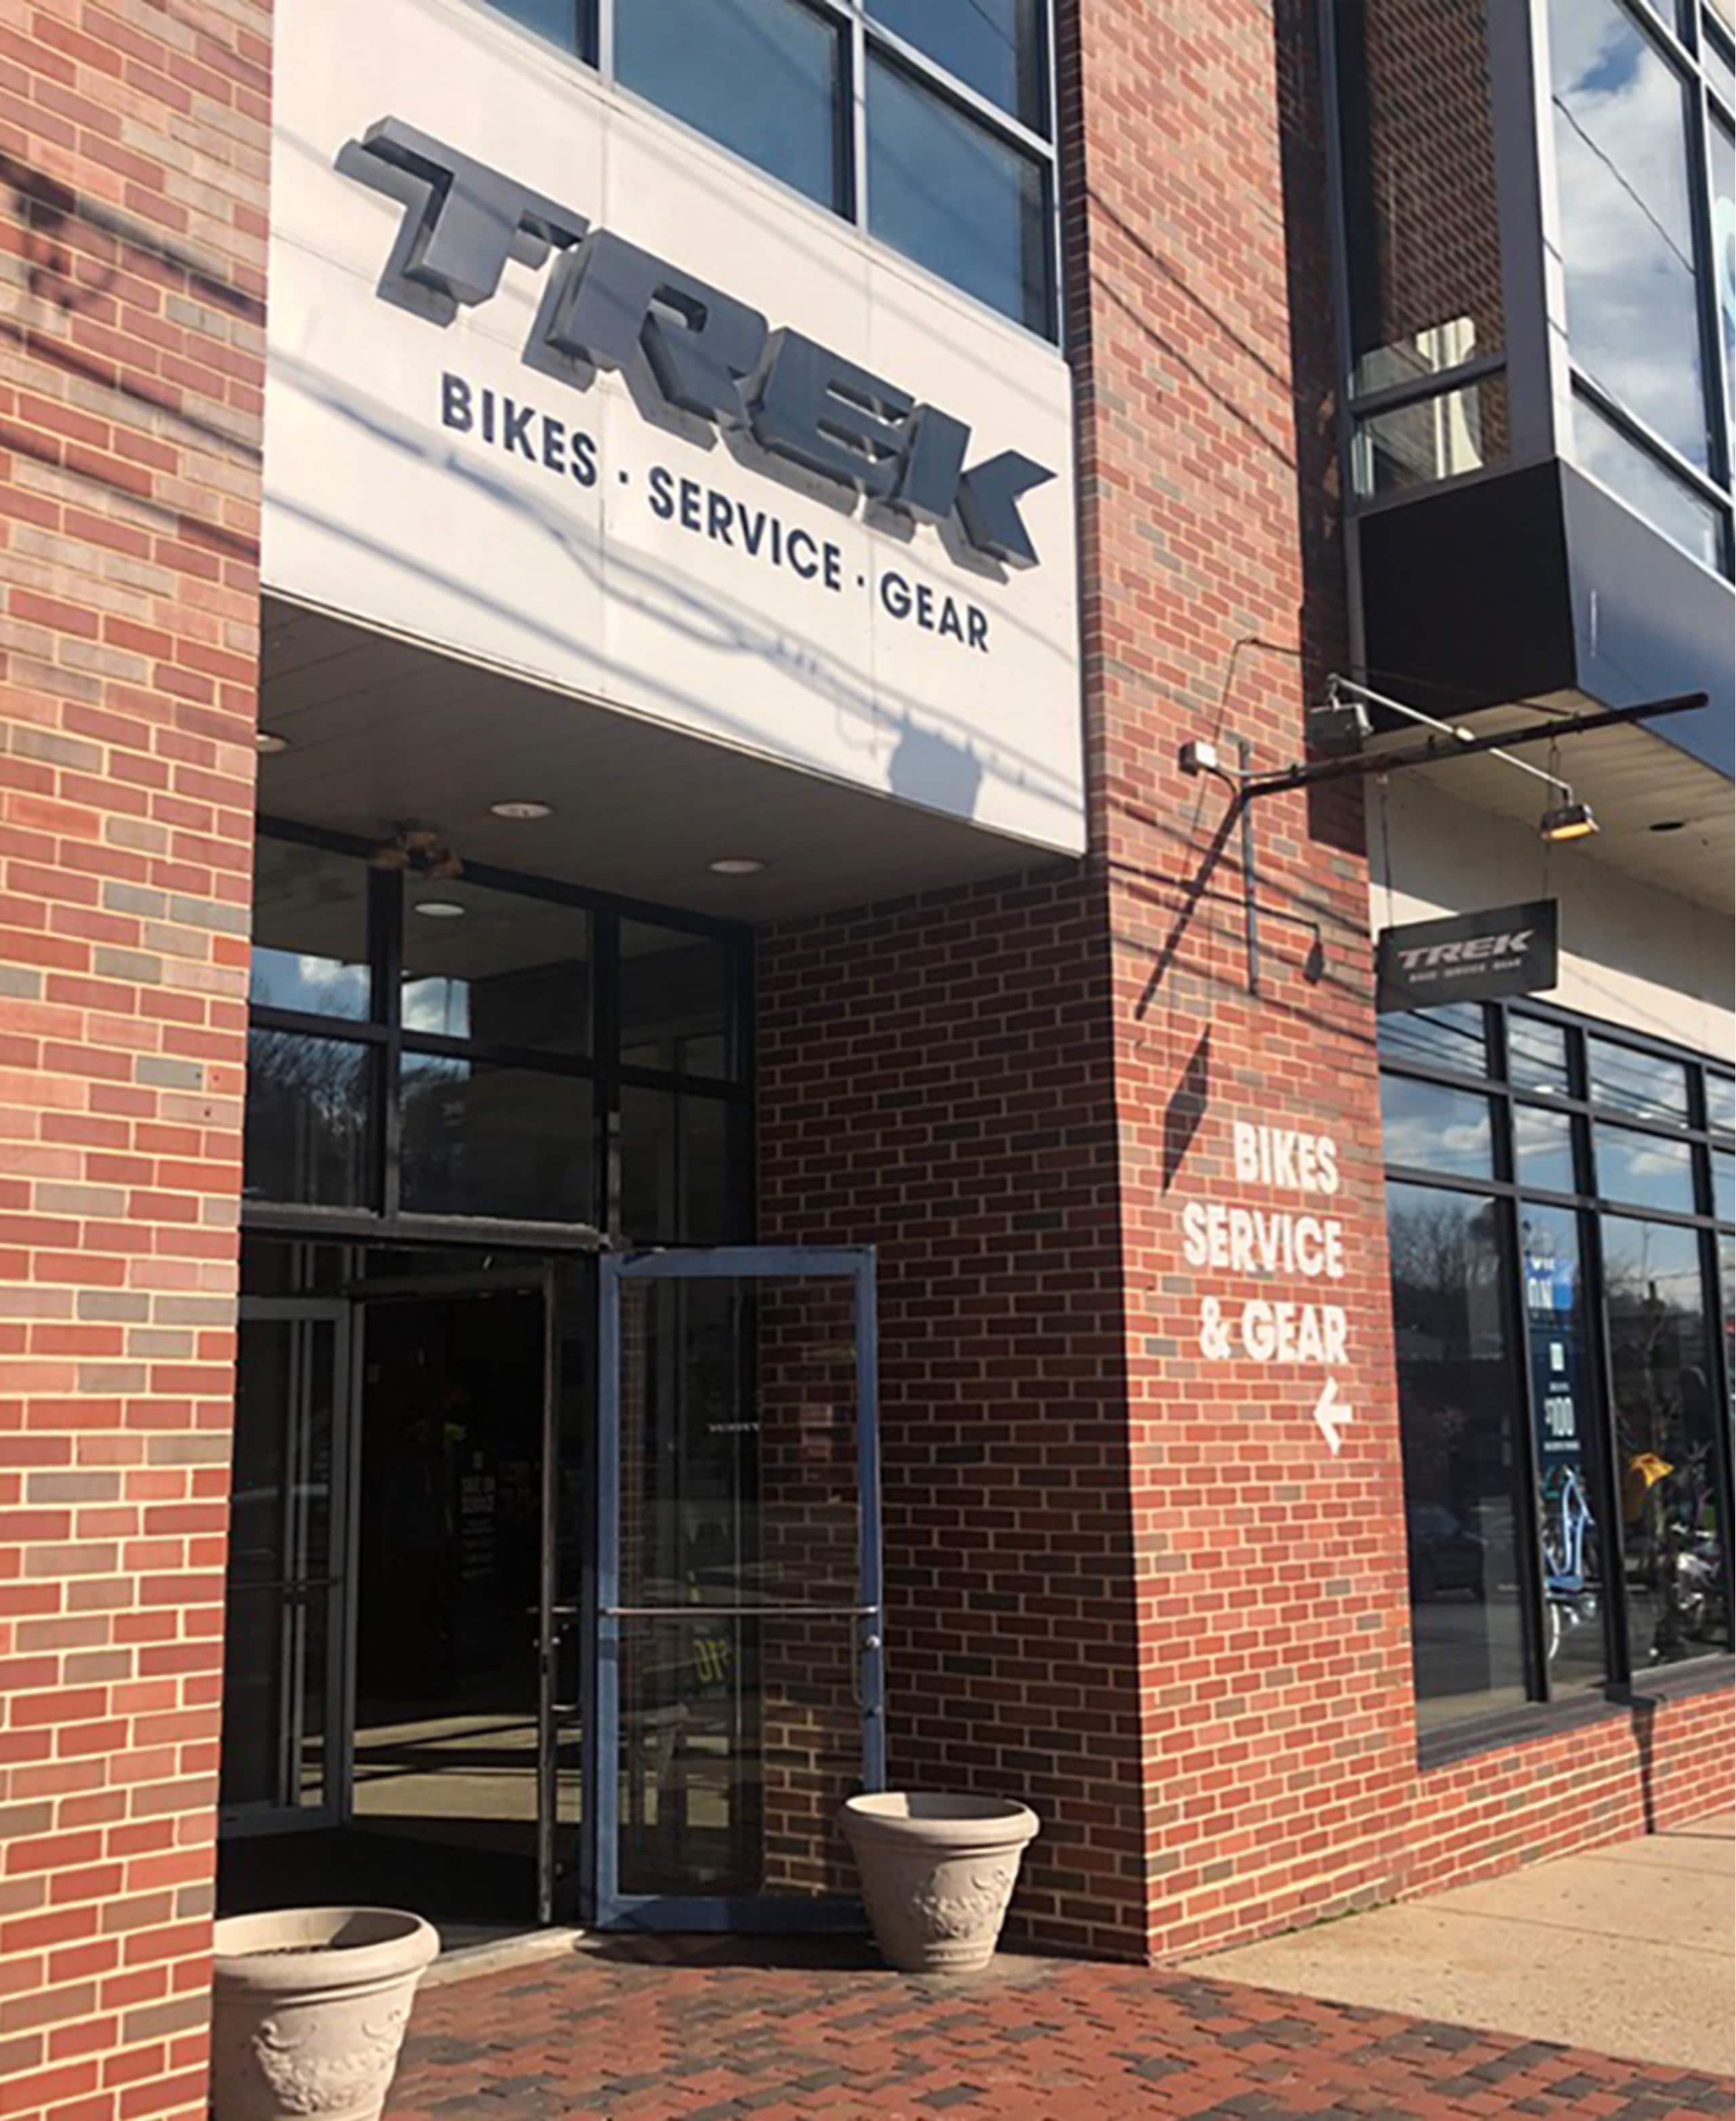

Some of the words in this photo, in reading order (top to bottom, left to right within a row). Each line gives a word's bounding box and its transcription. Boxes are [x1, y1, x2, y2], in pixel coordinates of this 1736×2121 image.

[334, 115, 1058, 584] TREK
[442, 372, 597, 488] BIKES
[648, 466, 841, 592] SERVICE
[880, 572, 989, 653] GEAR
[1398, 929, 1535, 970] TREK
[1234, 1121, 1339, 1195] BIKES
[1183, 1201, 1345, 1278] SERVICE
[1200, 1296, 1232, 1360] &
[1242, 1299, 1348, 1364] GEAR
